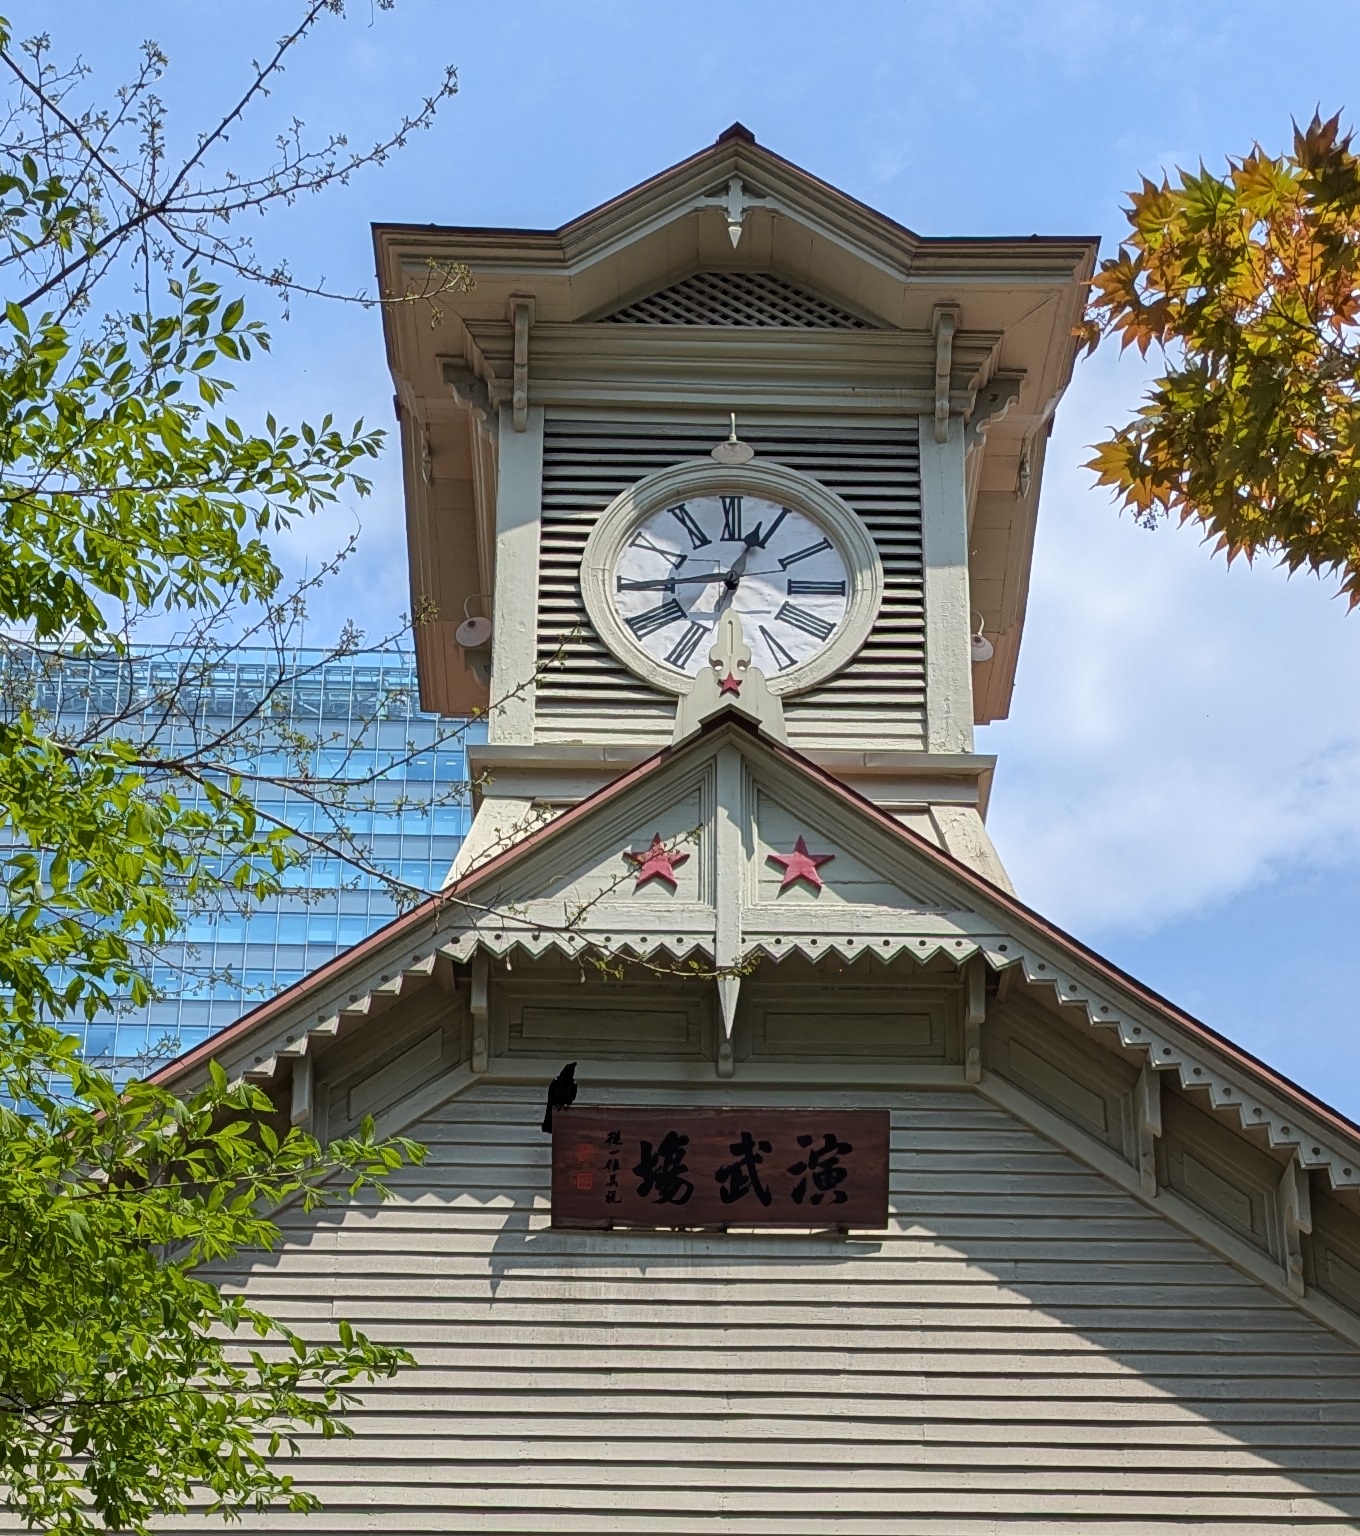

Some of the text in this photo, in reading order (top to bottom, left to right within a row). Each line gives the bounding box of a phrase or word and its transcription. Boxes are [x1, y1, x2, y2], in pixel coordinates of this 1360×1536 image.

[666, 503, 713, 550] XI
[719, 496, 744, 542] XII
[758, 506, 792, 549] I
[628, 531, 689, 570] X
[778, 537, 834, 571] II
[787, 578, 846, 597] III
